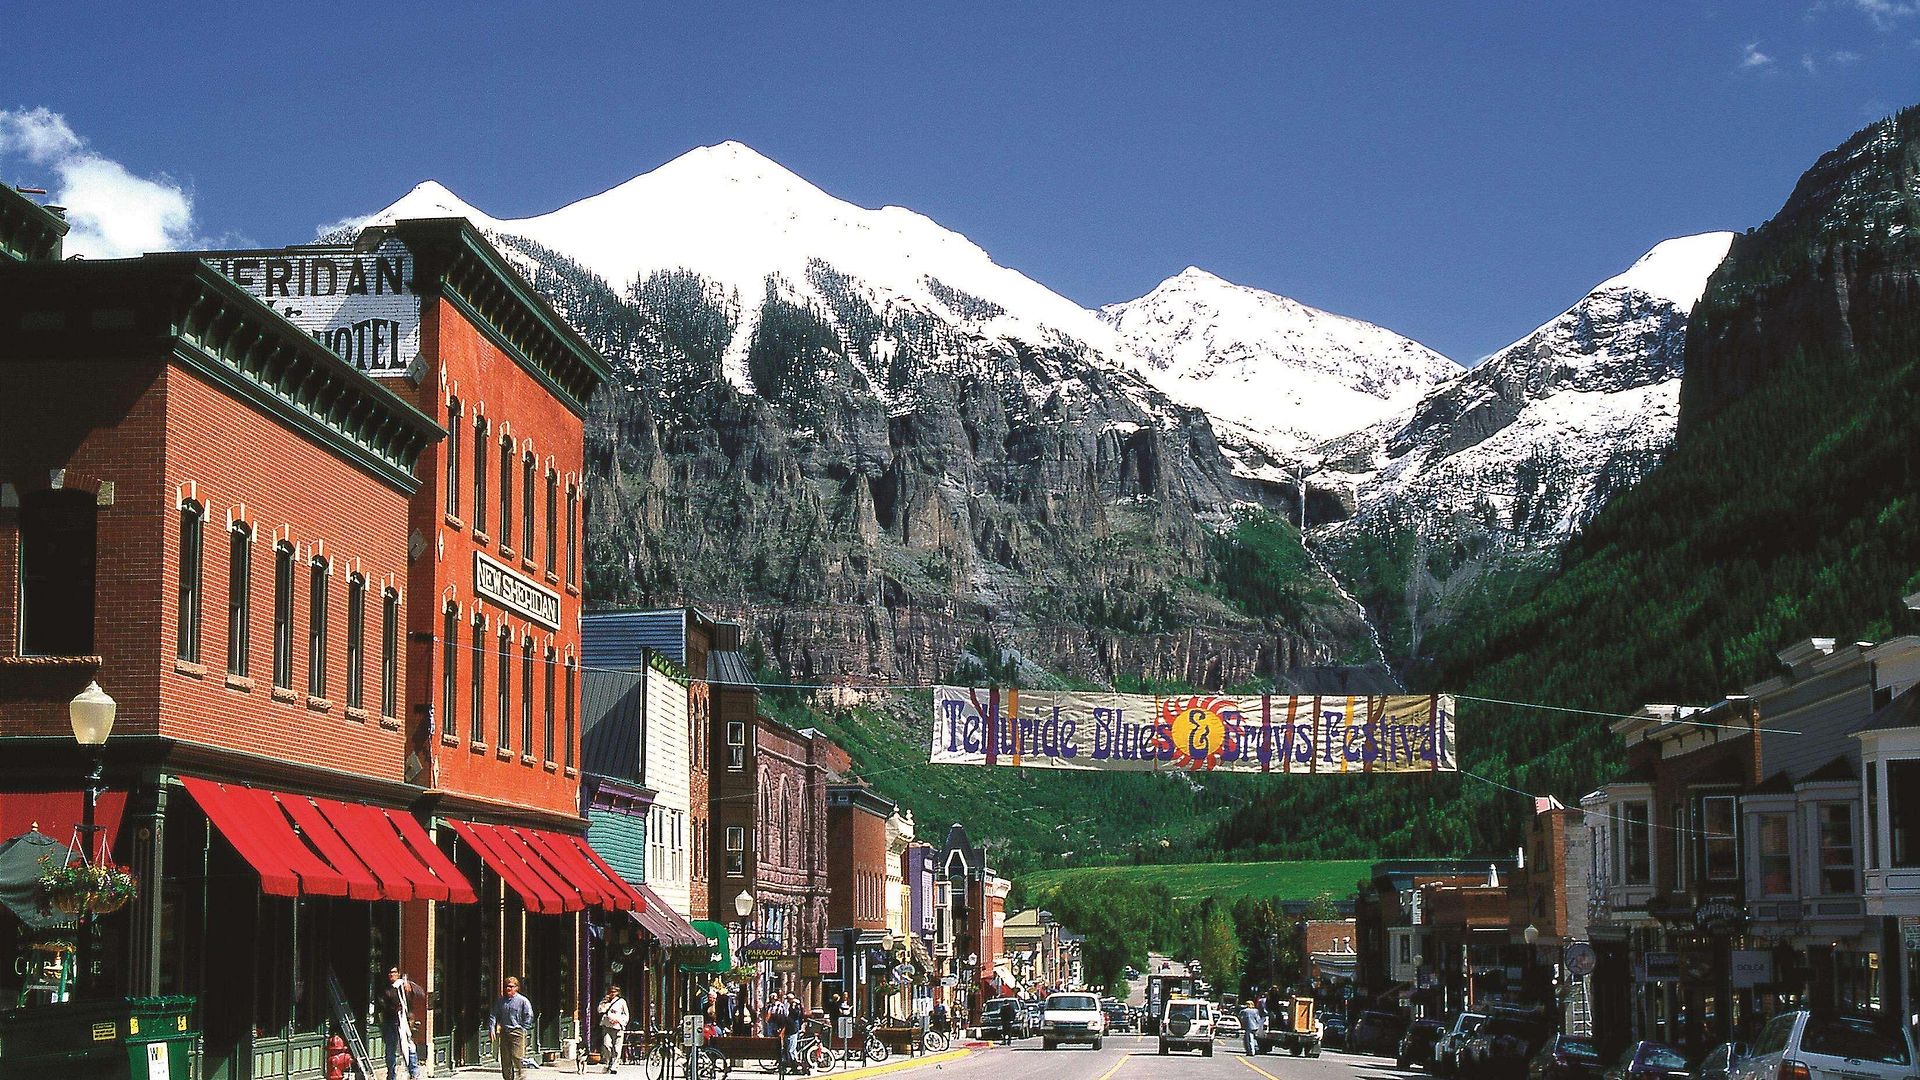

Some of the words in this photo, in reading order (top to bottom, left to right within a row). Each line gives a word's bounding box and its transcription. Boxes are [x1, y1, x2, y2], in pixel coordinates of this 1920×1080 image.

[219, 256, 402, 297] ERIDAN
[480, 562, 501, 596] NEW
[502, 574, 557, 623] SHERIDAN
[943, 700, 1077, 759] Telluride
[1091, 707, 1175, 761] Blues
[1188, 709, 1209, 759] &
[1323, 710, 1447, 762] Festival
